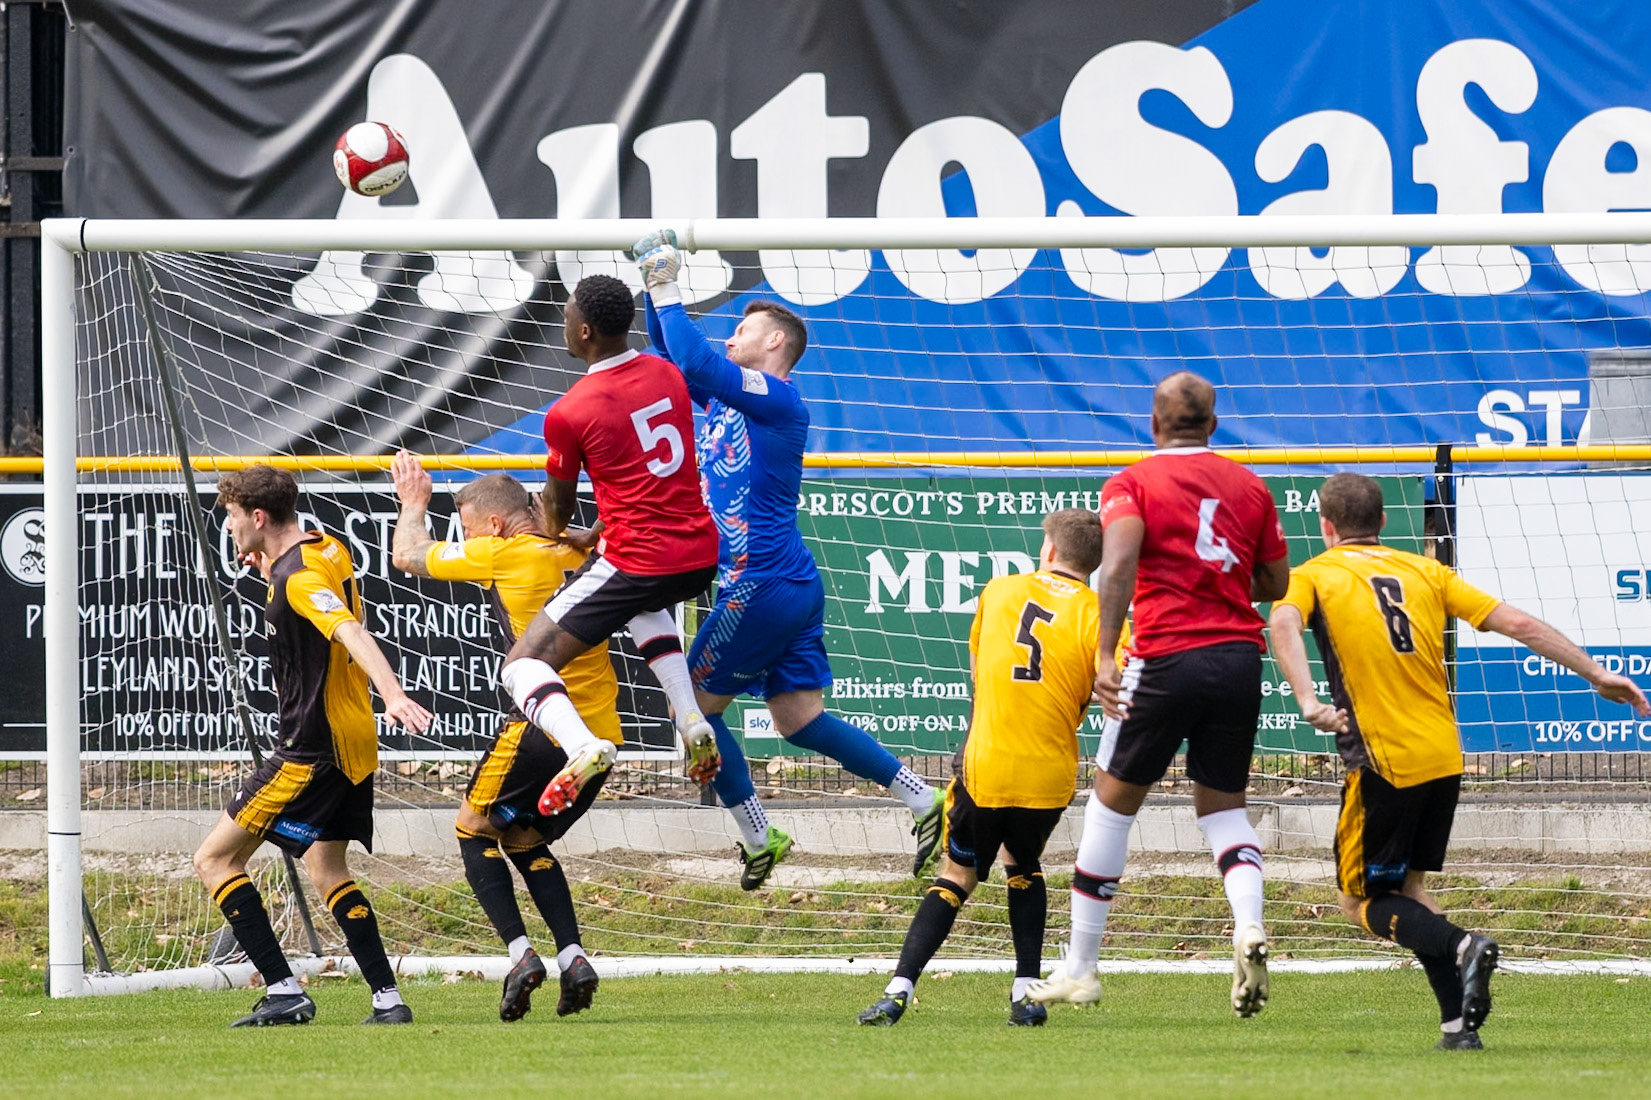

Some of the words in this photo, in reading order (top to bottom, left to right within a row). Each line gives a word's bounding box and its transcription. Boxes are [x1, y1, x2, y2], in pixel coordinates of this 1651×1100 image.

[630, 397, 685, 478] 5
[977, 490, 1102, 515] PREMIU
[1284, 489, 1321, 513] BA
[84, 513, 177, 579] THE
[1195, 498, 1240, 573] 4
[26, 604, 151, 639] PMIUM
[375, 603, 492, 639] STRANGE
[1368, 575, 1416, 655] 6
[1012, 600, 1056, 683] 5
[83, 656, 200, 692] LEYLAND
[401, 656, 460, 692] LATE
[831, 677, 905, 699] Elixirs
[911, 677, 968, 699] from
[116, 713, 154, 736] 10%
[158, 712, 191, 736] OFF
[195, 712, 222, 736] ON
[749, 716, 771, 731] sky
[883, 715, 920, 732] OFF
[924, 715, 953, 732] ON
[1535, 721, 1583, 742] 10%
[1586, 721, 1634, 742] OFF
